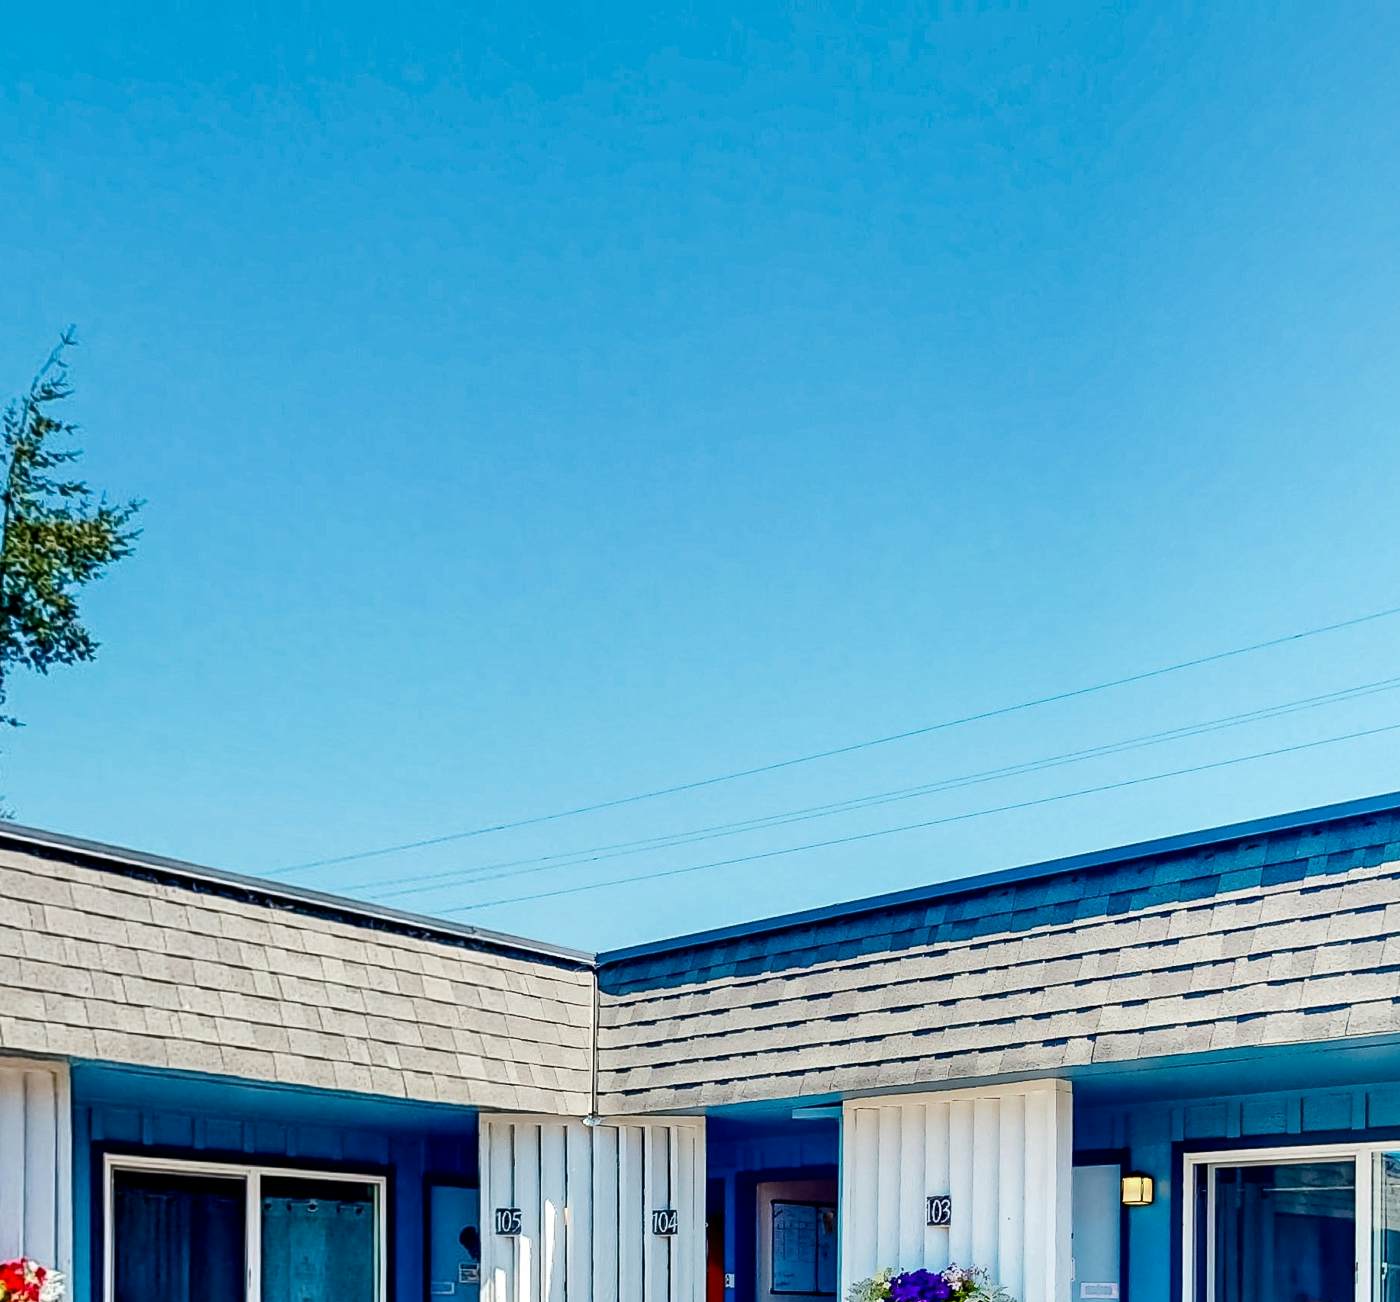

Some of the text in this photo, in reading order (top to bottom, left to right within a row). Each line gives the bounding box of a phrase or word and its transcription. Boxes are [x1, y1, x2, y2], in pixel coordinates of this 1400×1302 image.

[497, 1210, 522, 1232] 105
[652, 1211, 678, 1233] 104
[927, 1199, 950, 1223] 103
